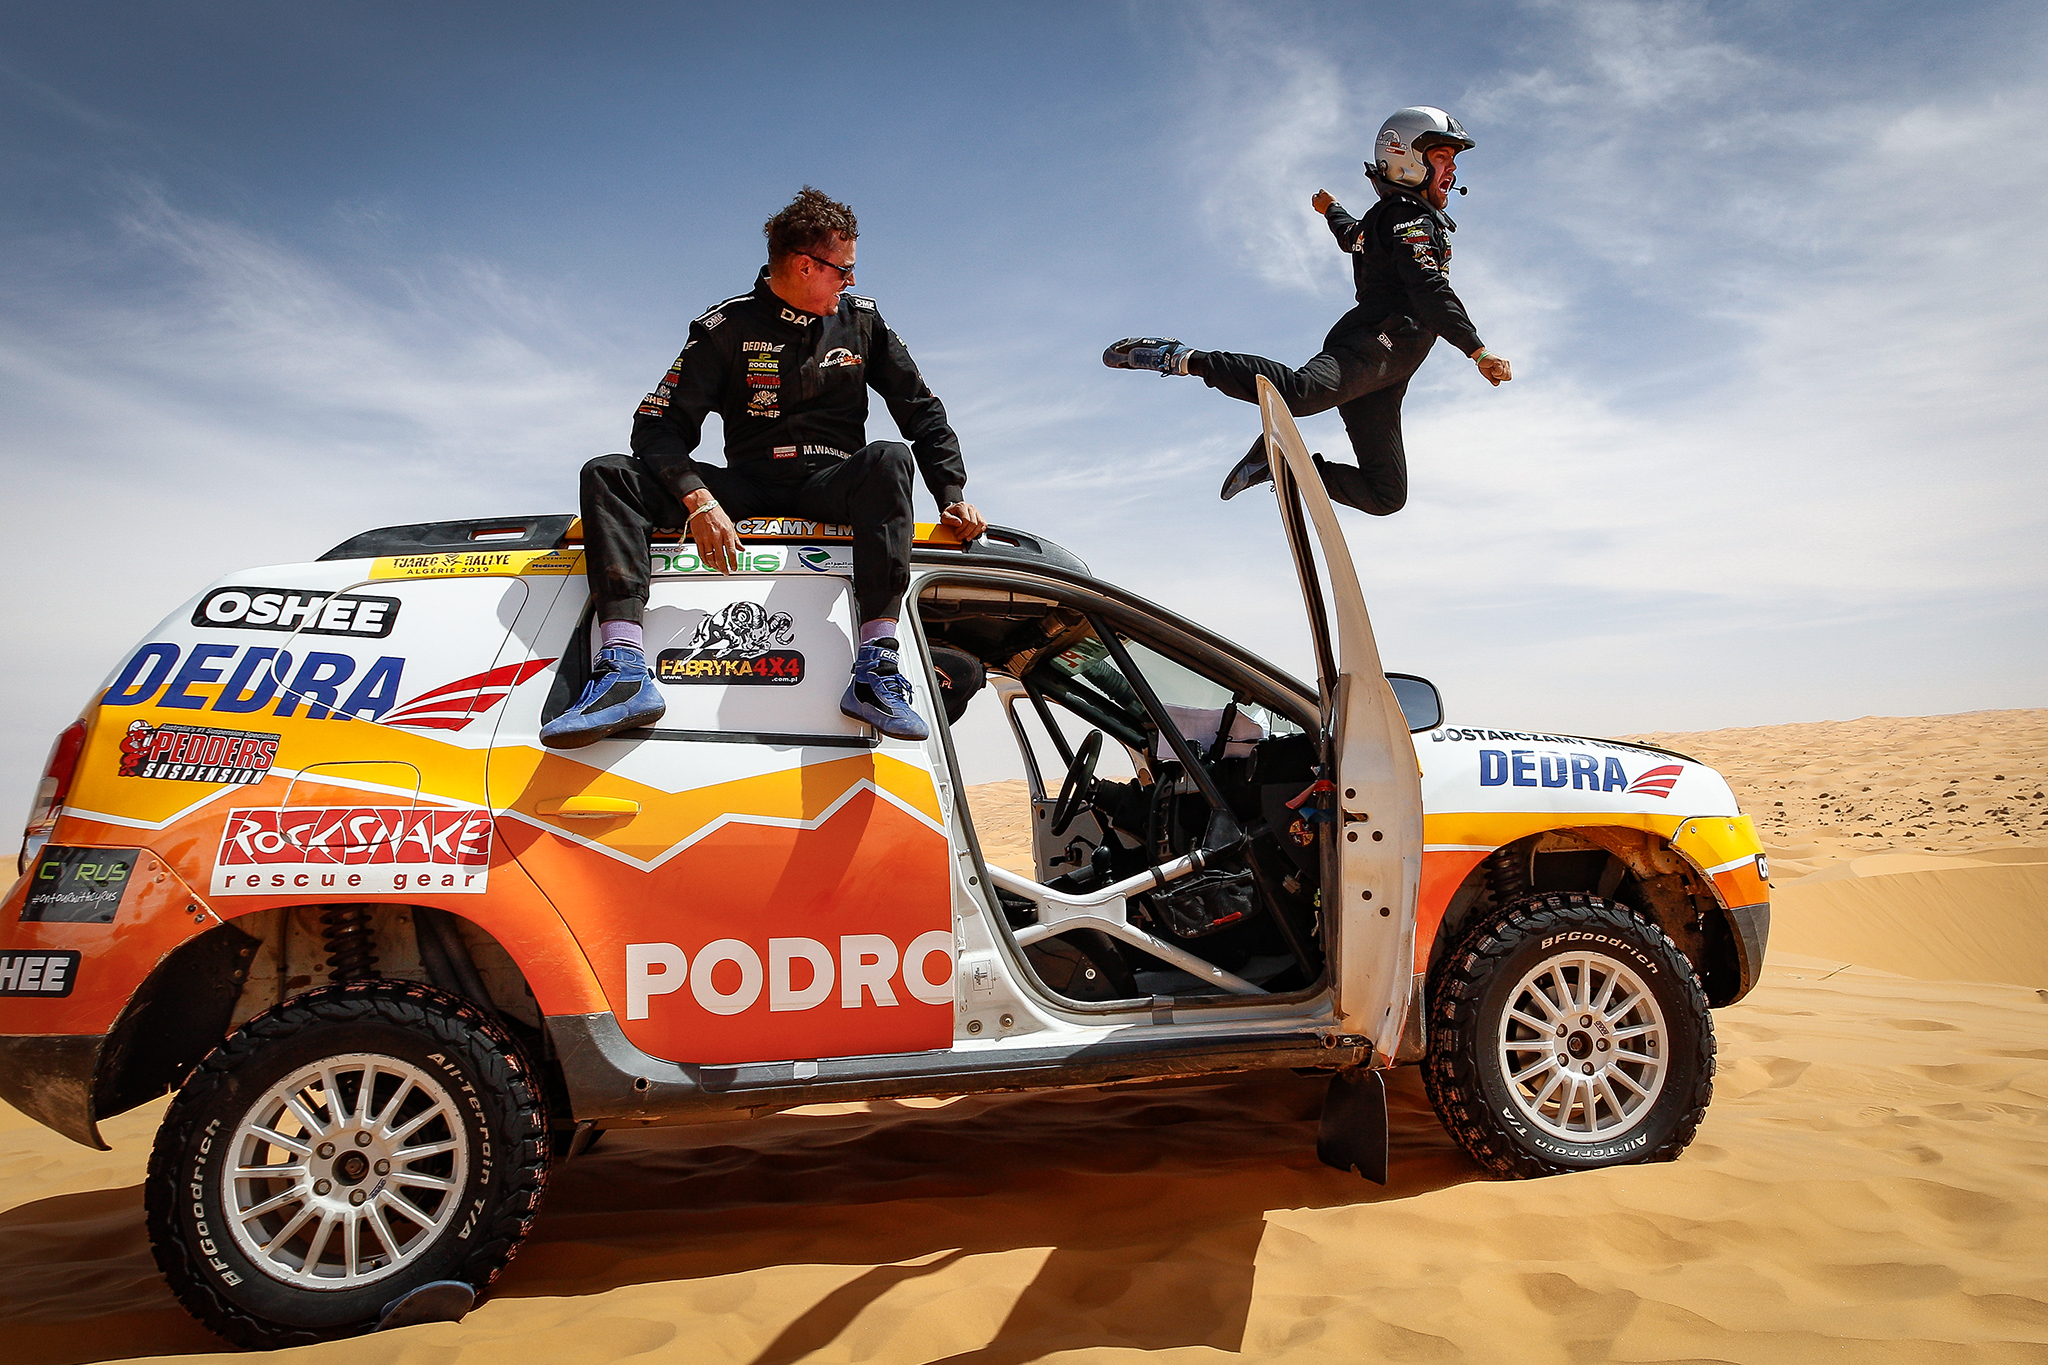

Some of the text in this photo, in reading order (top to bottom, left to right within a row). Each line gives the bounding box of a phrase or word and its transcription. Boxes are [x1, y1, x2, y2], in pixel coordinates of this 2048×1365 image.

[705, 313, 724, 328] OMP
[742, 341, 773, 352] DEDRA
[748, 361, 768, 369] ROCK
[406, 566, 490, 575] ALGÉRIE 2019
[205, 591, 390, 633] OSHEE
[99, 642, 406, 722] DEDRA
[148, 730, 279, 771] PEDDERS
[1431, 728, 1587, 747] DOSTARCZAMY
[142, 762, 266, 785] SUSPENSION
[1479, 749, 1629, 793] DEDRA
[224, 872, 476, 890] rescue gear
[1540, 930, 1660, 976] BFGoodrich
[0, 956, 71, 992] HEE
[625, 929, 954, 1020] PODRO
[1501, 1106, 1530, 1138] T/A
[190, 1117, 244, 1288] BFGoodrich
[457, 1198, 486, 1241] T/A
